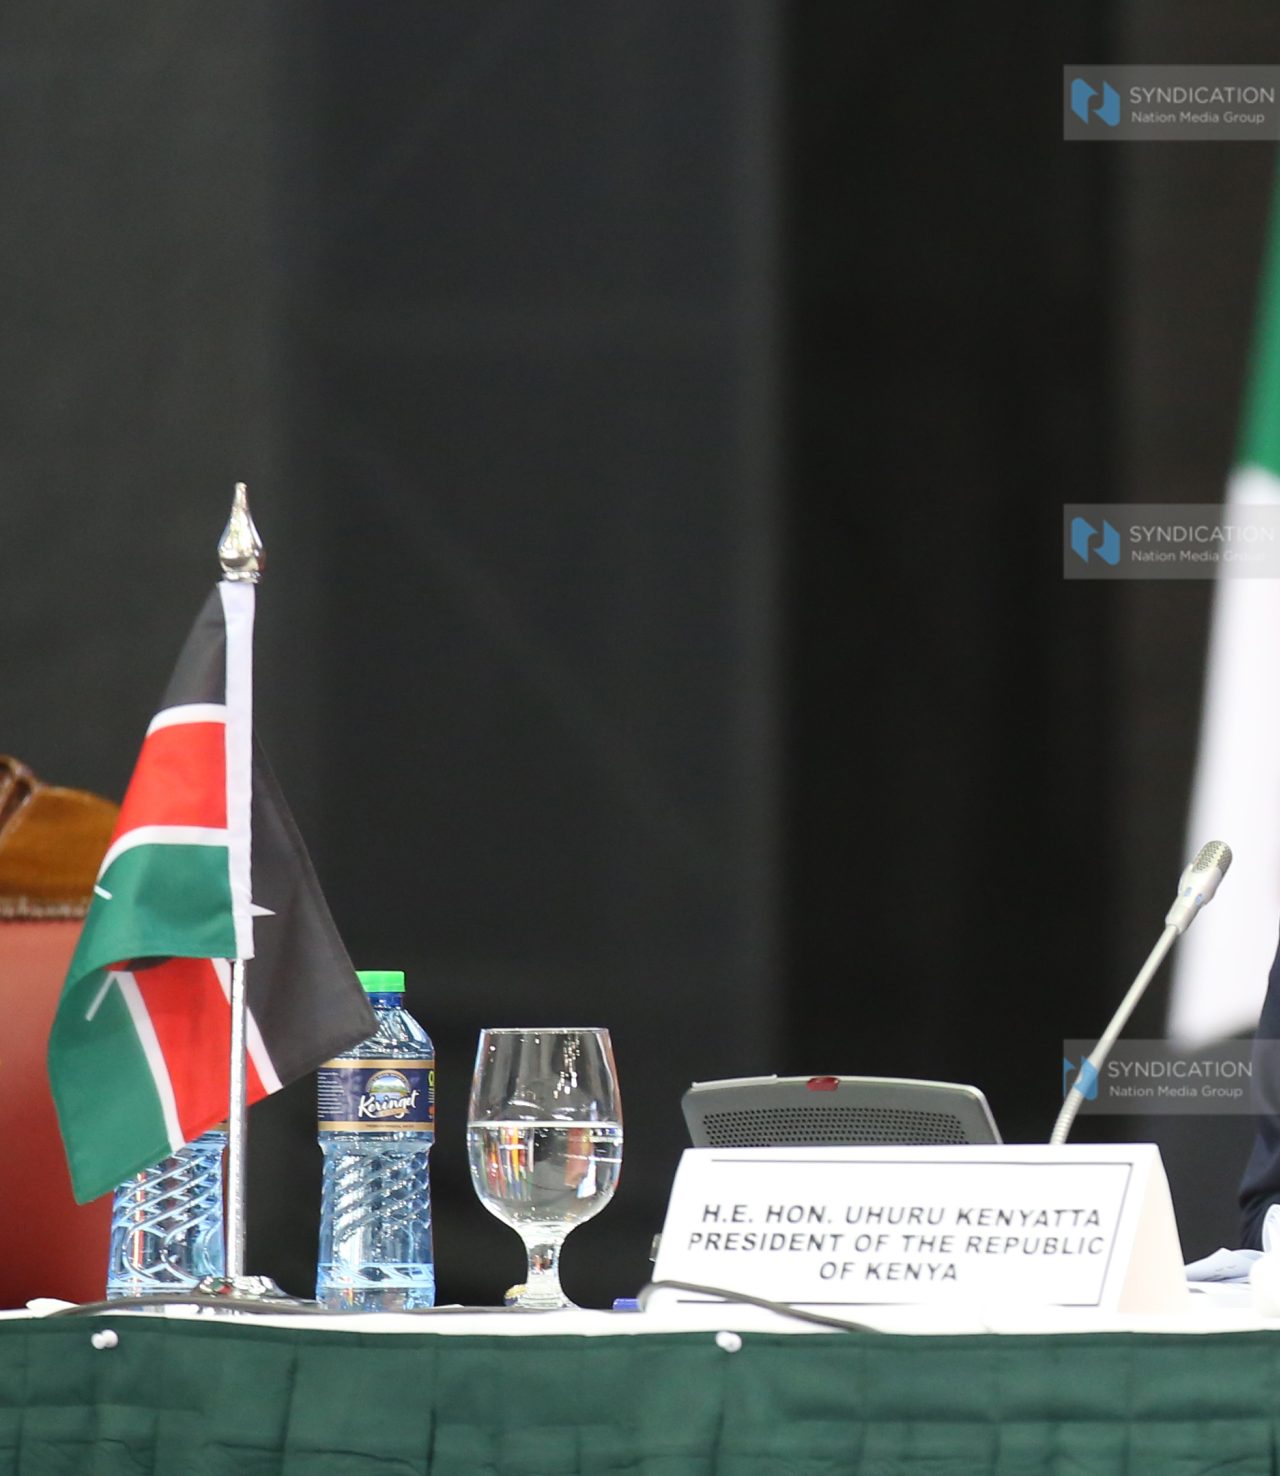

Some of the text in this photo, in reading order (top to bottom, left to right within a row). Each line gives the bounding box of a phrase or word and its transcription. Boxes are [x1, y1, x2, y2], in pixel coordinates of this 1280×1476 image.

[358, 1089, 420, 1118] Keringet
[703, 1205, 1099, 1226] H.E. HON. UHURU KENYATTA
[690, 1233, 1103, 1254] PRESIDENT OF THE REPUBLIC
[820, 1262, 956, 1280] OF KENYA
